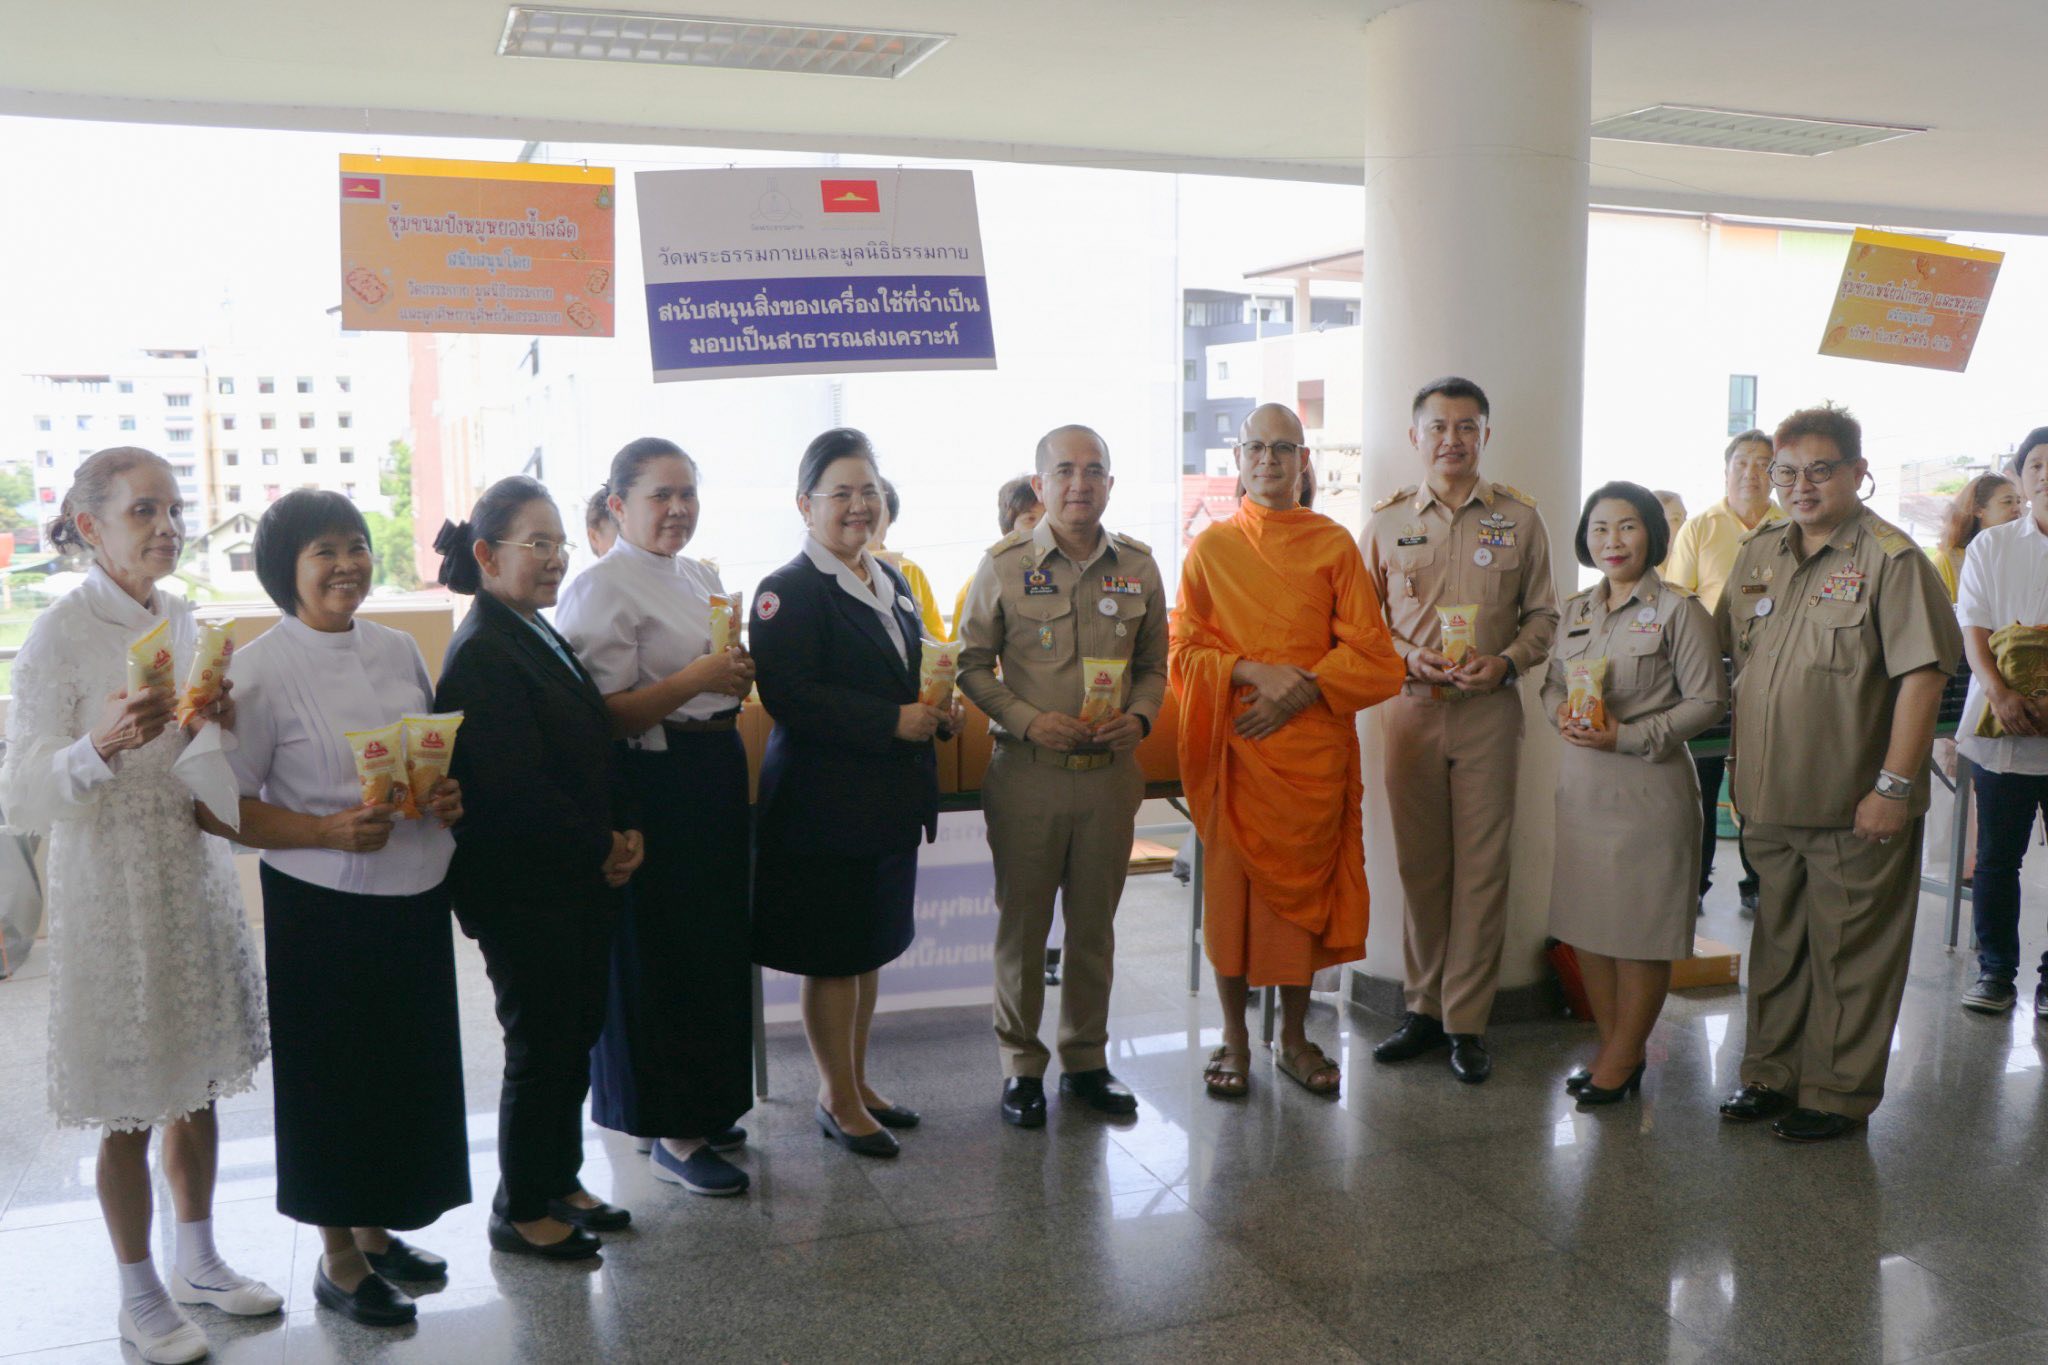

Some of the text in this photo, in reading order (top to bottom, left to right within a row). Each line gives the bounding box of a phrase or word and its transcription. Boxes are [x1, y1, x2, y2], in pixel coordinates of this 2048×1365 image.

[658, 241, 969, 267] วัดพระธรรมกายและมูลนิธิธรรมกาย
[658, 284, 981, 327] สนับสนุนสิ่งของเครื่องใช้ที่จำเป็น
[690, 321, 960, 355] มอบเป็นสาธารณสงเคราะห์
